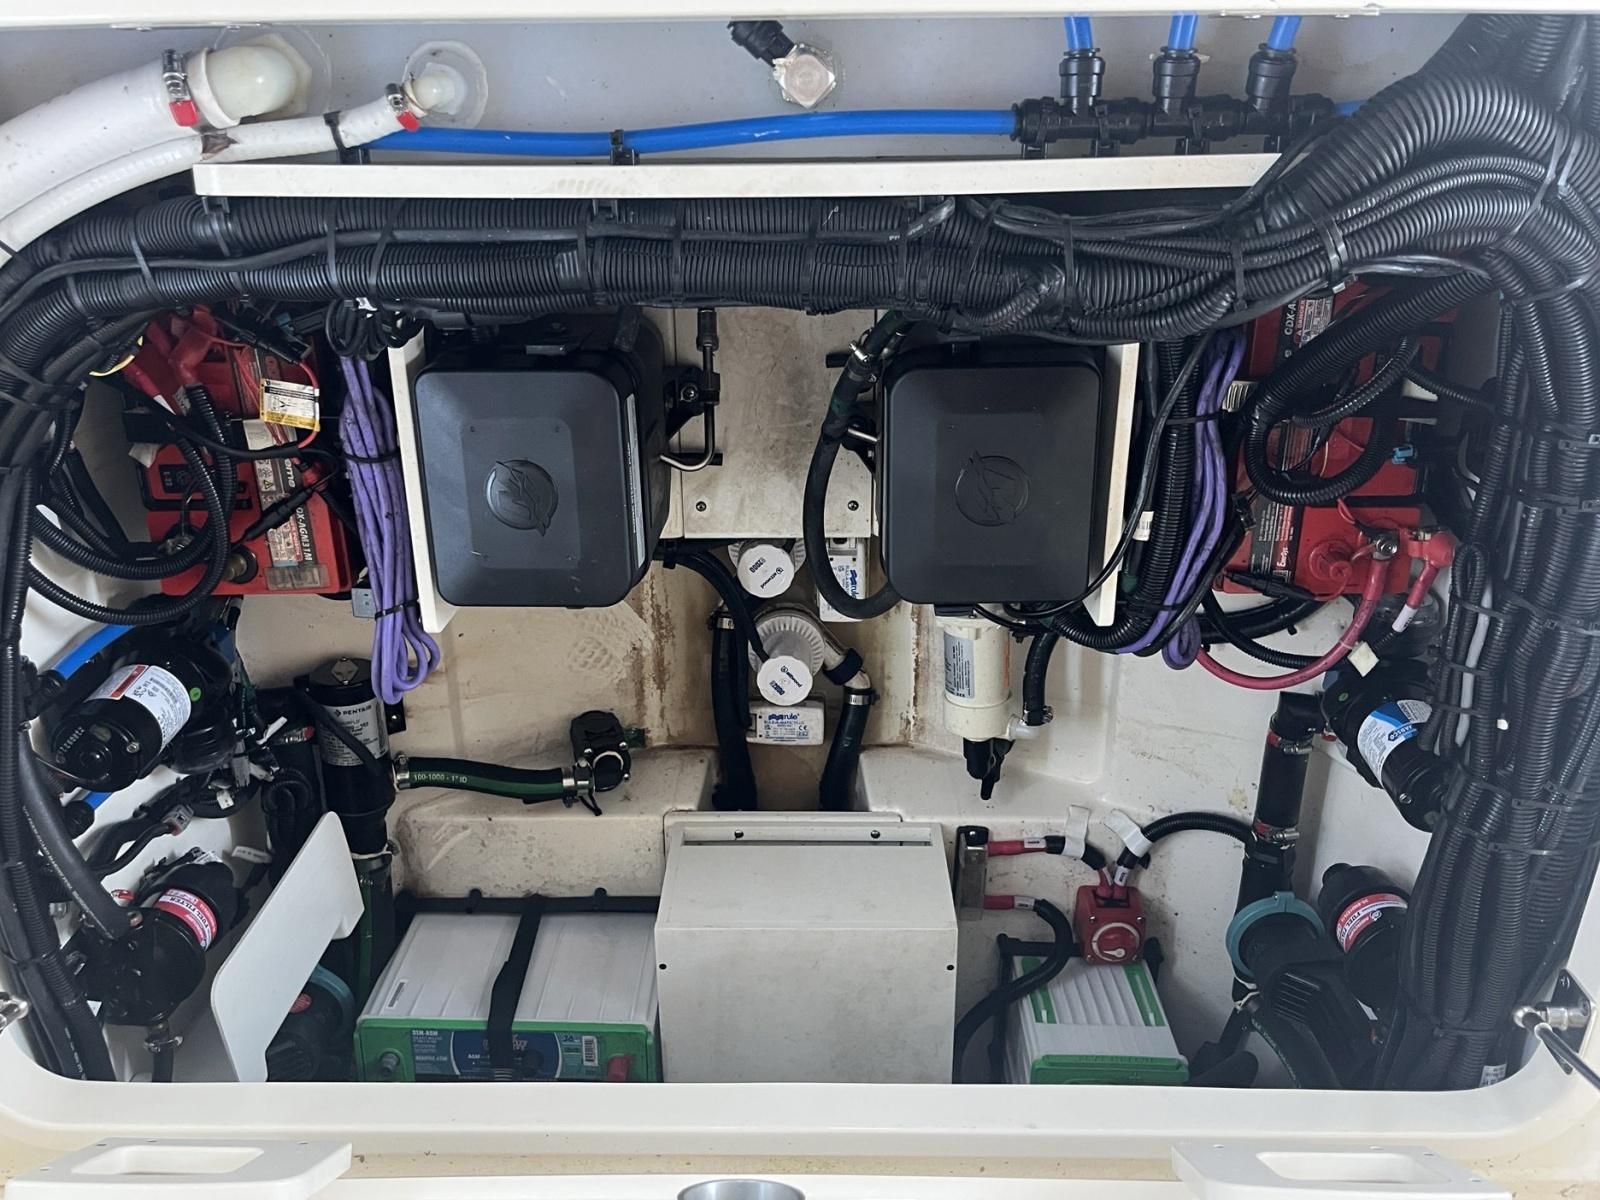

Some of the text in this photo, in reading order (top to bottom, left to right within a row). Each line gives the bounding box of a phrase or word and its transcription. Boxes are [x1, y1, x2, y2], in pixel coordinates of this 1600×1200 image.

[786, 672, 803, 688] attwood
[343, 705, 372, 715] PENTAIR
[1389, 725, 1412, 740] JABSCO
[170, 897, 208, 929] FUEL FILTER
[1346, 912, 1360, 928] FUEL
